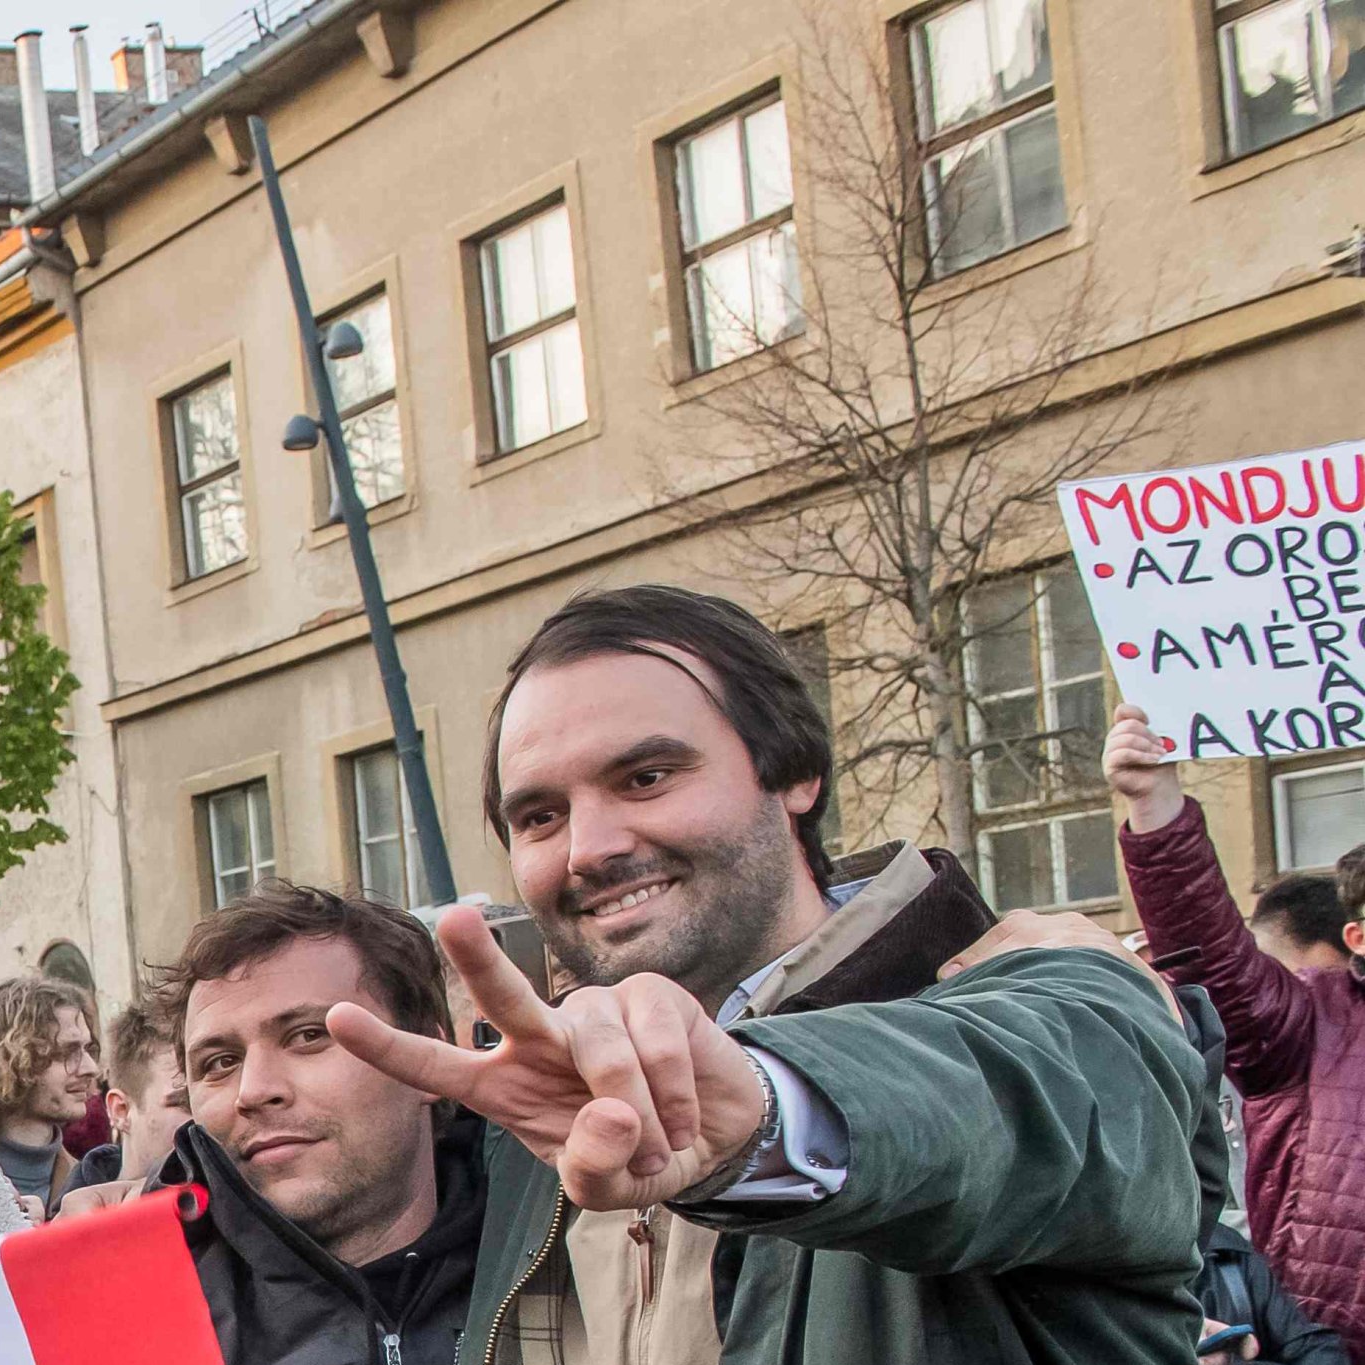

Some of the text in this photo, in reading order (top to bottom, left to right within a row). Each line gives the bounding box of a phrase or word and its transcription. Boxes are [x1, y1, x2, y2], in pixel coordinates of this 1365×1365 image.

[1075, 454, 1365, 545] MONDJU
[1127, 520, 1365, 588] AZ ORO
